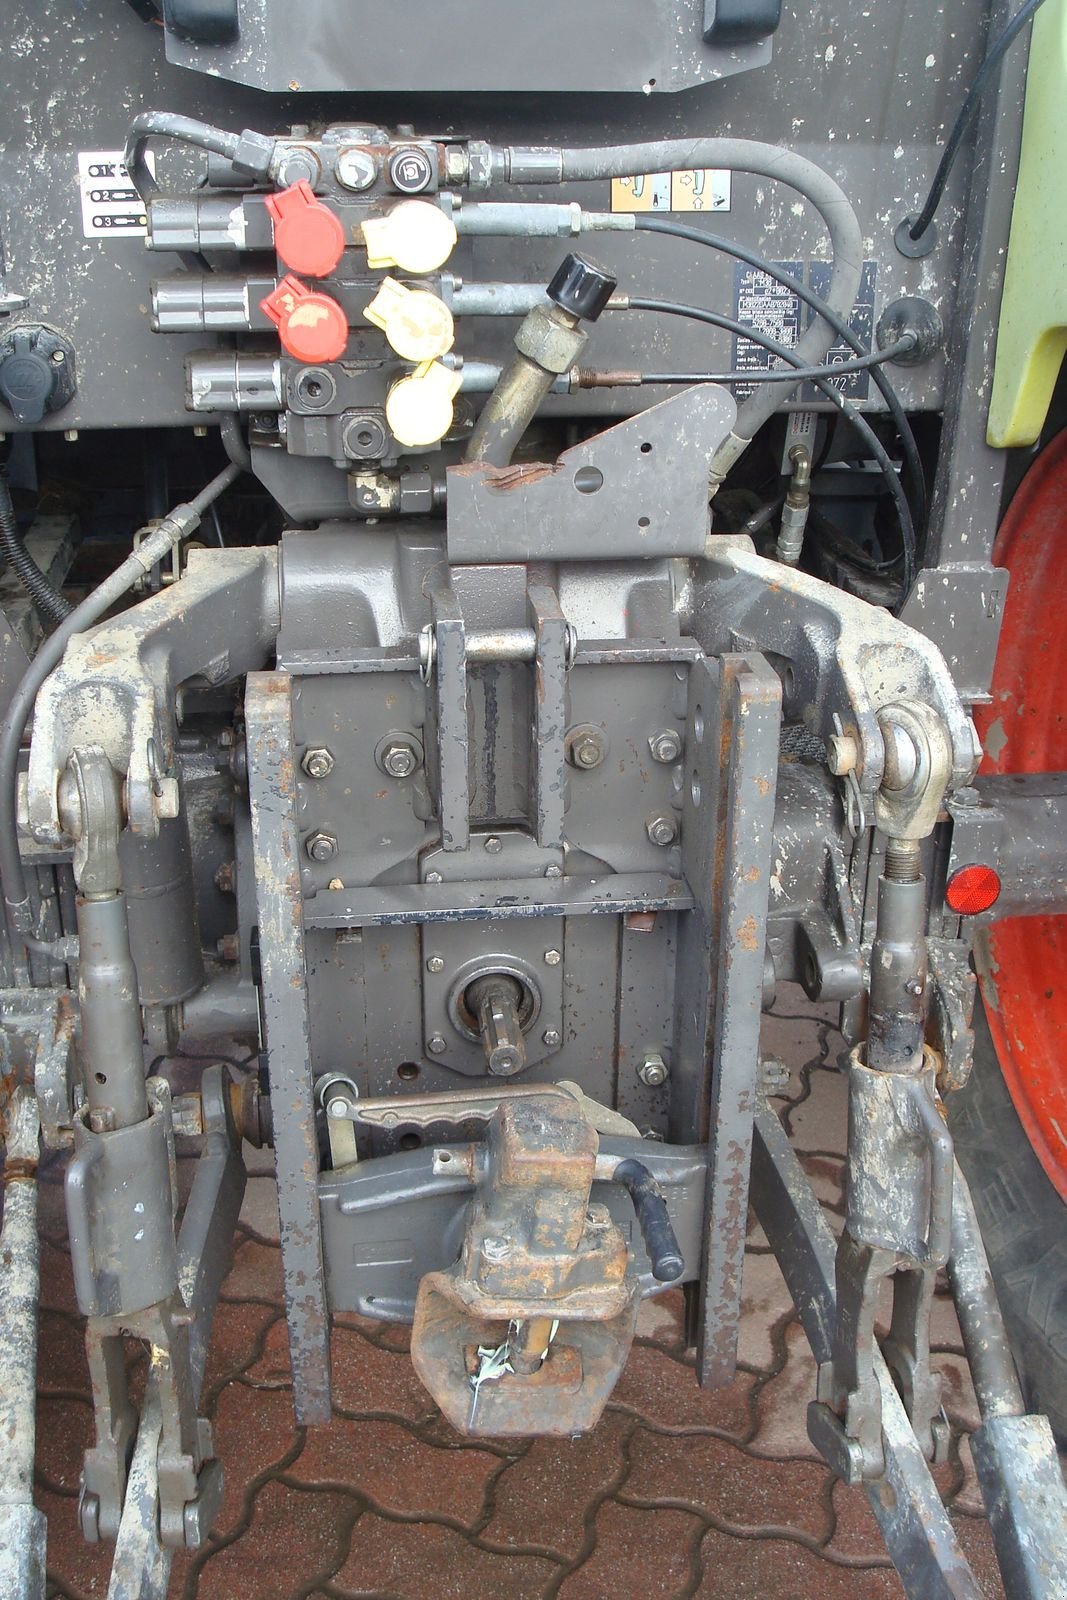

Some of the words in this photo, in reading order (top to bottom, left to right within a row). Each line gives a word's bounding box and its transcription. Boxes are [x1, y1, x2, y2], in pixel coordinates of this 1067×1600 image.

[101, 168, 107, 176] 1
[102, 190, 110, 200] 2
[104, 217, 112, 227] 3
